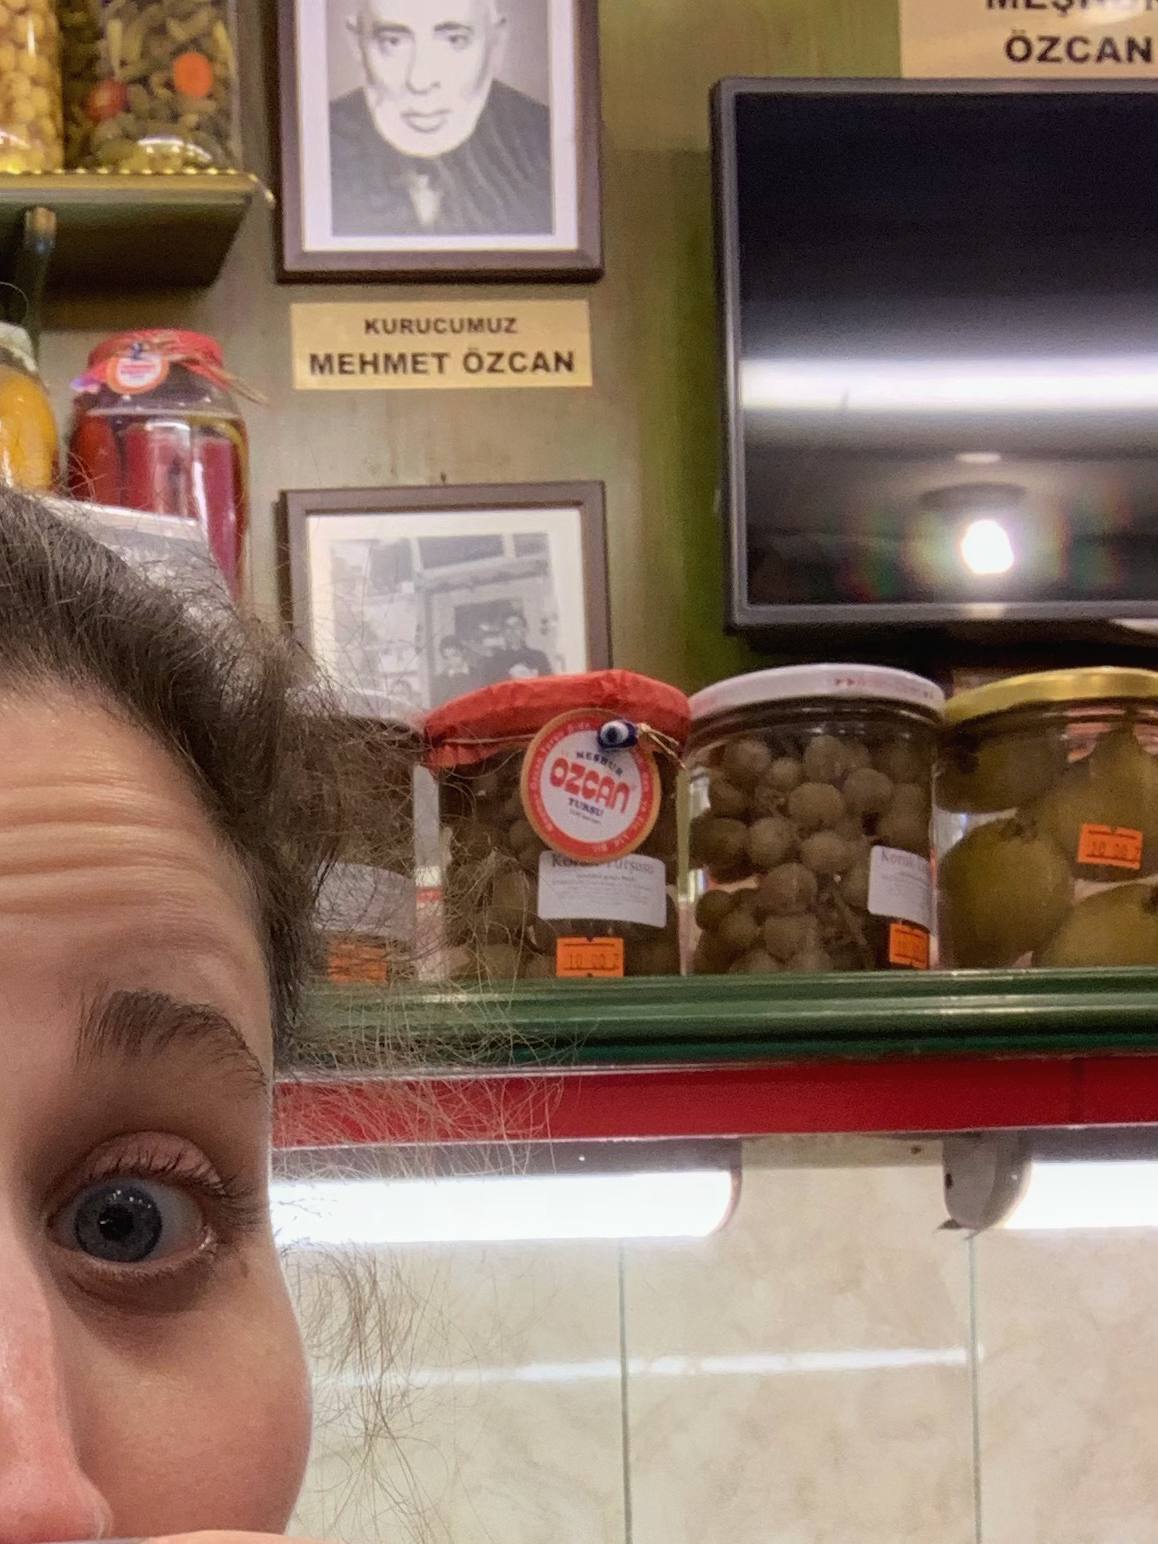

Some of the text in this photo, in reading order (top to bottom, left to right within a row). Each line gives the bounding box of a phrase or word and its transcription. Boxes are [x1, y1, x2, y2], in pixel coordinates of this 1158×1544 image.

[1004, 28, 1153, 64] ÖZCAN
[364, 317, 519, 336] KURUCUMUZ
[309, 347, 575, 376] MEHMET ÖZCAN
